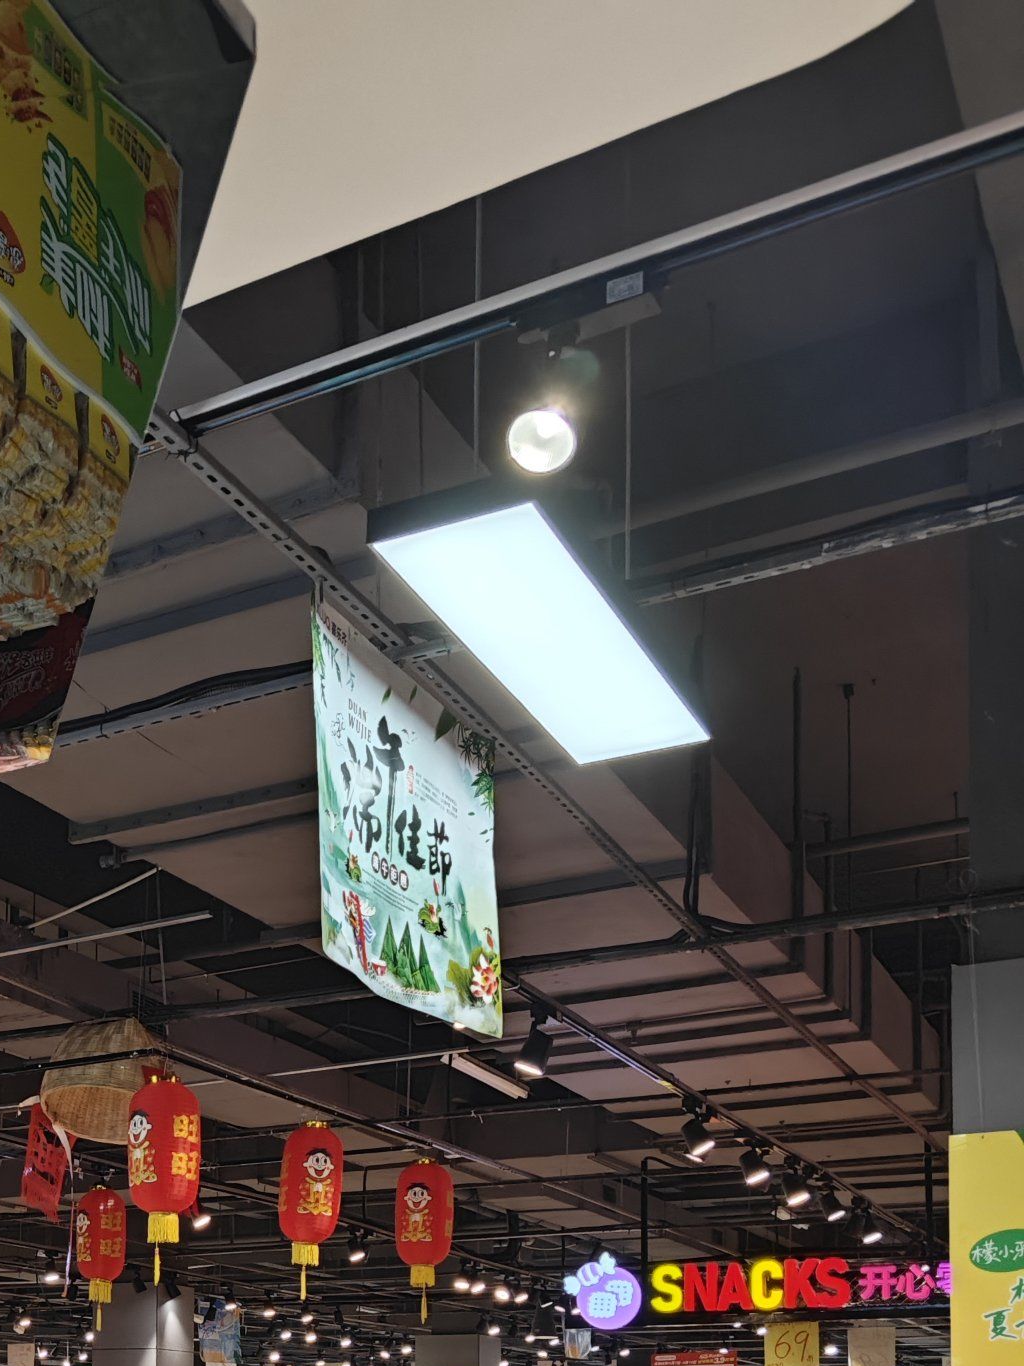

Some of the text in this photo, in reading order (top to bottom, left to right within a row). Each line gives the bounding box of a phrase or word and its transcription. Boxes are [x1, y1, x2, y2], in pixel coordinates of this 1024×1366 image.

[348, 699, 367, 722] DUAN
[348, 713, 372, 743] WUJIE
[651, 1258, 851, 1313] SNACKS
